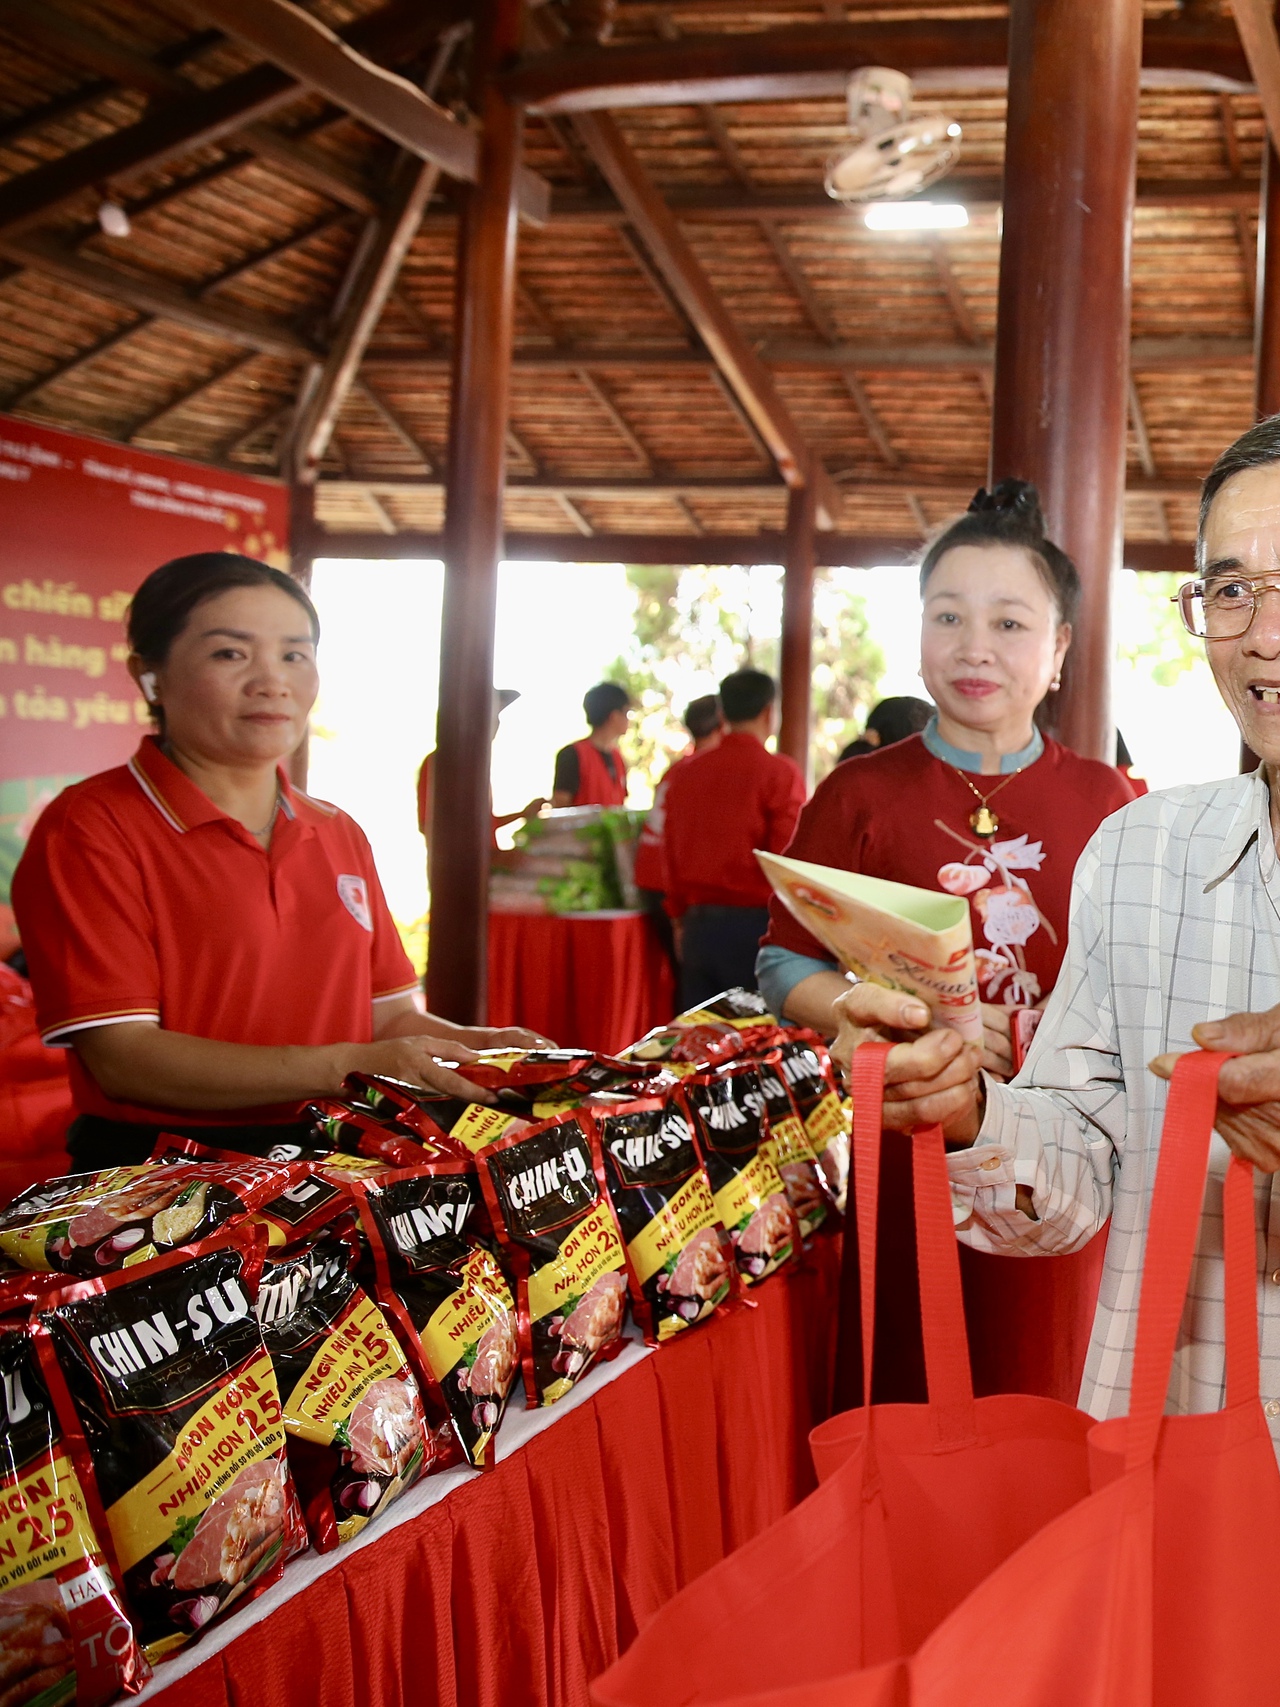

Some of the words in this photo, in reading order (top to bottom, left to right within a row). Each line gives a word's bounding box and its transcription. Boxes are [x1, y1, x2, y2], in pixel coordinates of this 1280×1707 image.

[90, 1282, 249, 1378] CHIN-SU
[0, 1538, 17, 1567] N
[42, 1546, 60, 1563] 400
[60, 1545, 67, 1557] g
